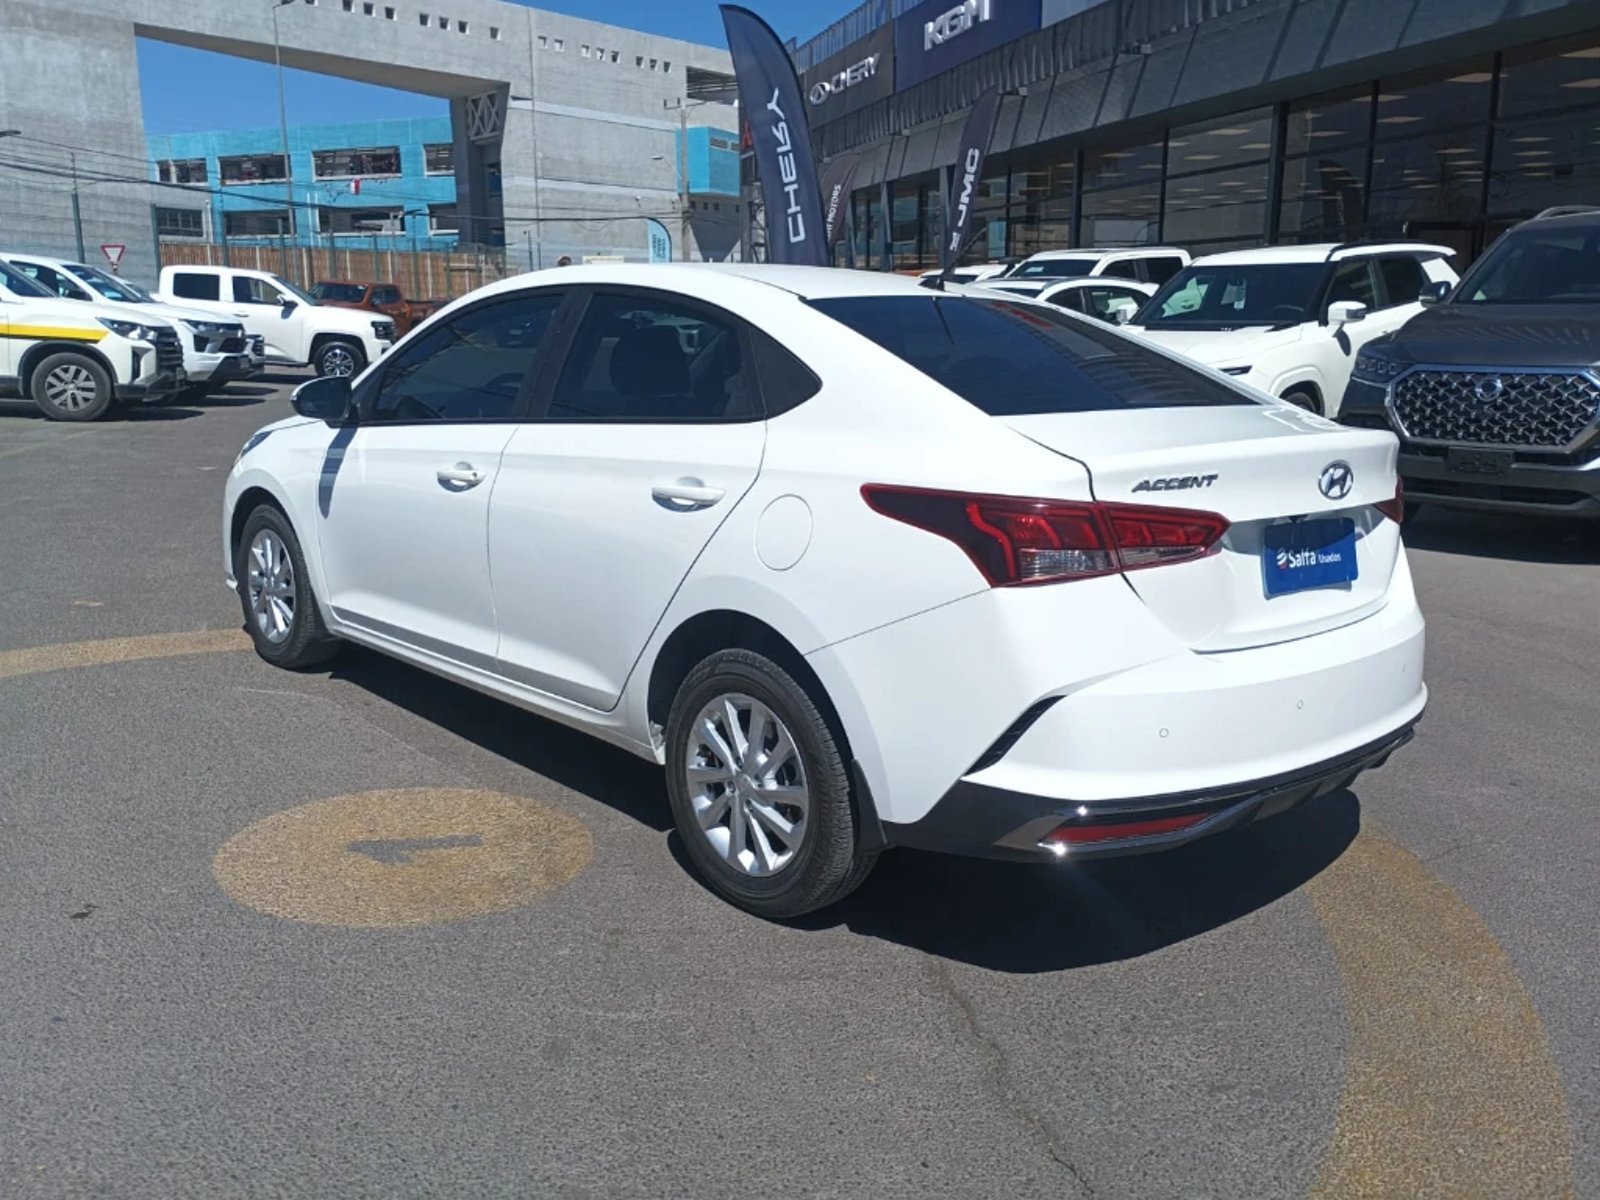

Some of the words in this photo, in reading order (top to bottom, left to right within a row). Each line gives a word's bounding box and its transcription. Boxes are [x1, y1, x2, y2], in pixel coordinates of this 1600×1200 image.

[924, 0, 990, 50] KGM
[831, 53, 880, 94] CHERY
[767, 88, 805, 243] CHERY
[827, 184, 841, 222] MOTORS
[1131, 474, 1218, 493] ACCENT
[1288, 548, 1316, 568] Salfa
